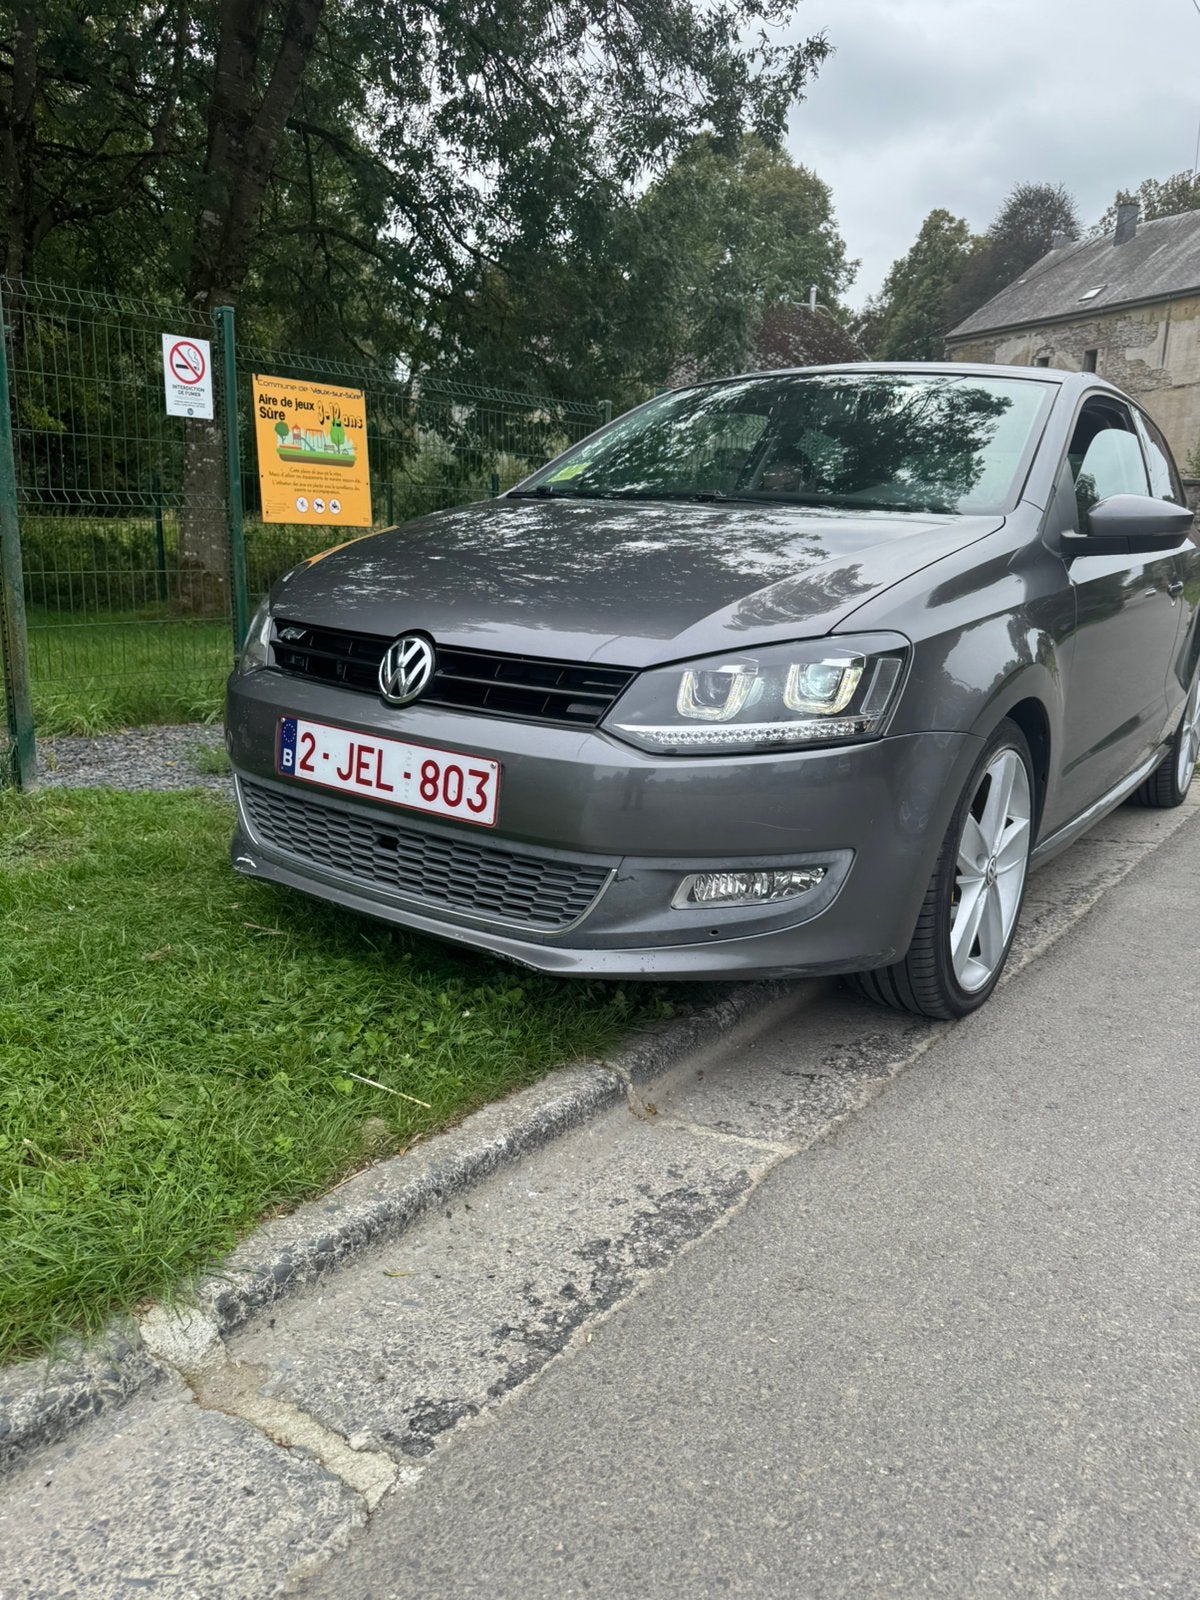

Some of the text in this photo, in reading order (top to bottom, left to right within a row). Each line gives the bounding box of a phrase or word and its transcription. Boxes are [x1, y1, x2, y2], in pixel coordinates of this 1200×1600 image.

[172, 384, 205, 393] INTERDICTION
[257, 379, 297, 391] Commune
[258, 394, 315, 411] Aire de jeux
[259, 406, 286, 420] Sûre
[343, 413, 363, 429] ans
[282, 748, 293, 767] B
[299, 731, 490, 814] 2-JEL-803
